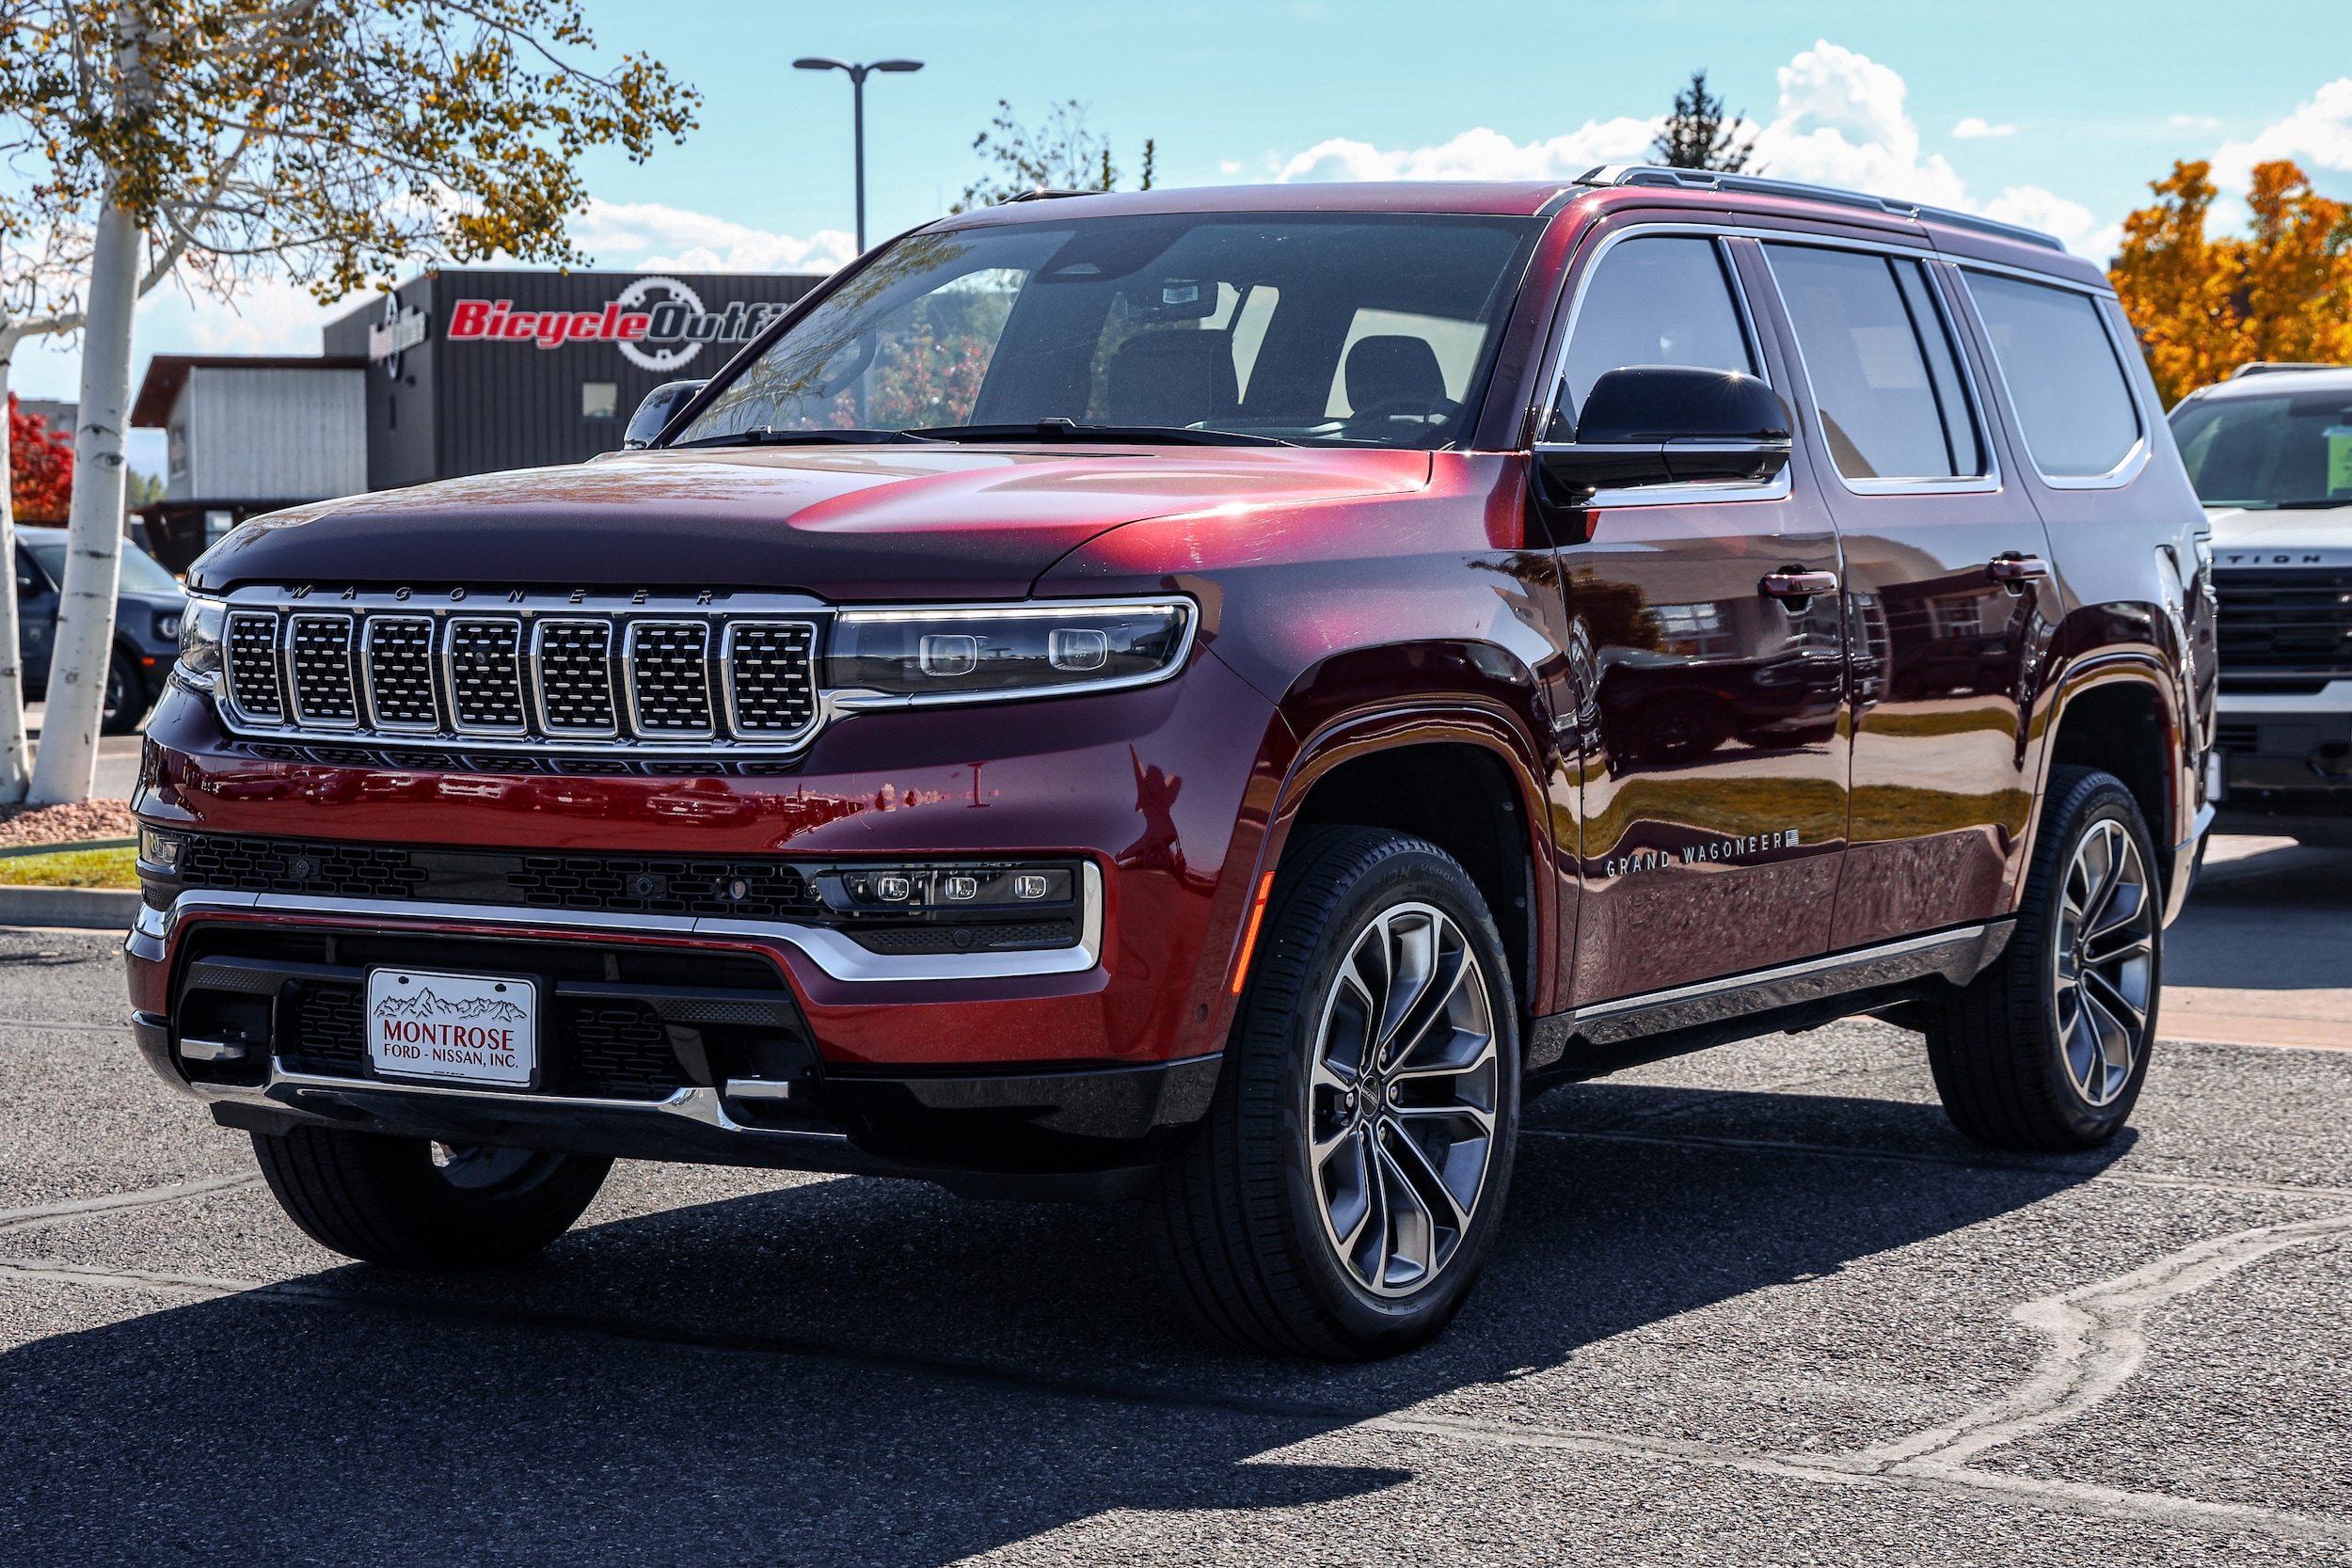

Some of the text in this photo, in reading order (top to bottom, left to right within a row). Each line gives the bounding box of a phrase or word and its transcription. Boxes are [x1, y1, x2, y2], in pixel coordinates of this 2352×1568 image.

[291, 584, 713, 606] WAGONEER
[1605, 832, 1782, 878] GRAND WAGONEER
[384, 1019, 515, 1052] MONTROSE
[384, 1043, 421, 1059] FORD
[433, 1048, 486, 1069] NISSAN,
[490, 1053, 518, 1069] INC.
